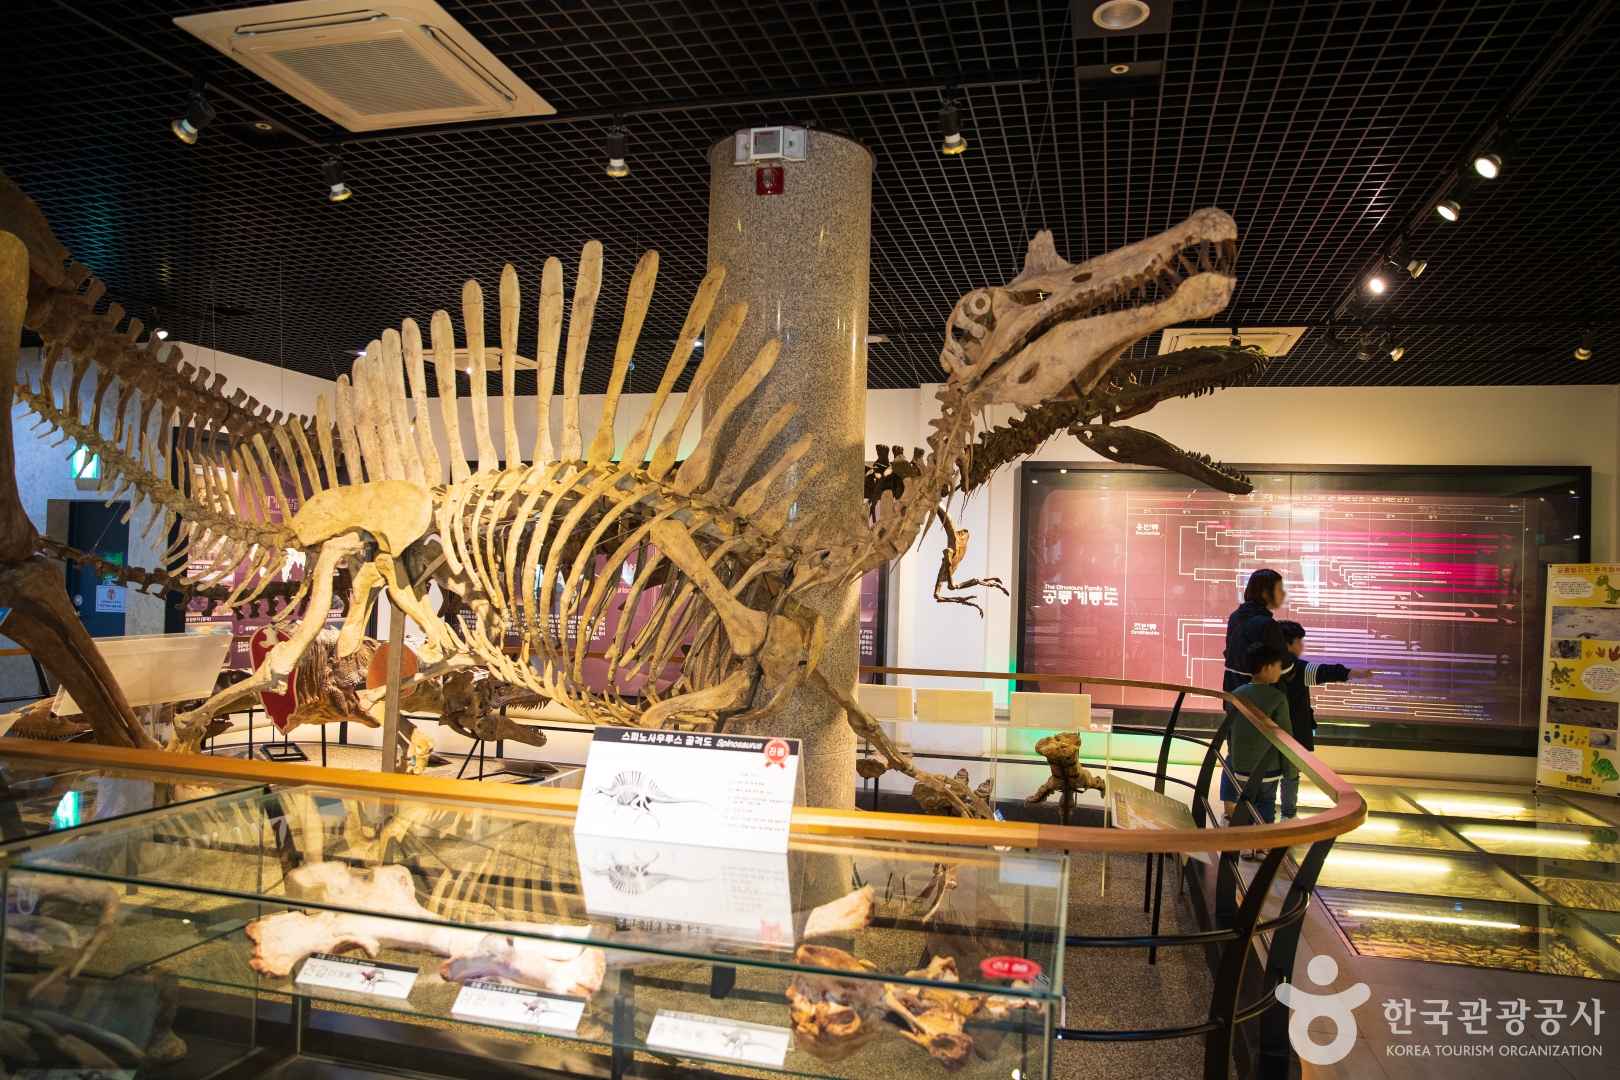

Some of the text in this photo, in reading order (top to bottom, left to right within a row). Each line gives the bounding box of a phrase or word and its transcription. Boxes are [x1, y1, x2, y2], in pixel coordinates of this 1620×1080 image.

[1042, 590, 1119, 607] 공룡계통도
[621, 731, 763, 750] 스피노사우루스 골격도 Spinosaurus
